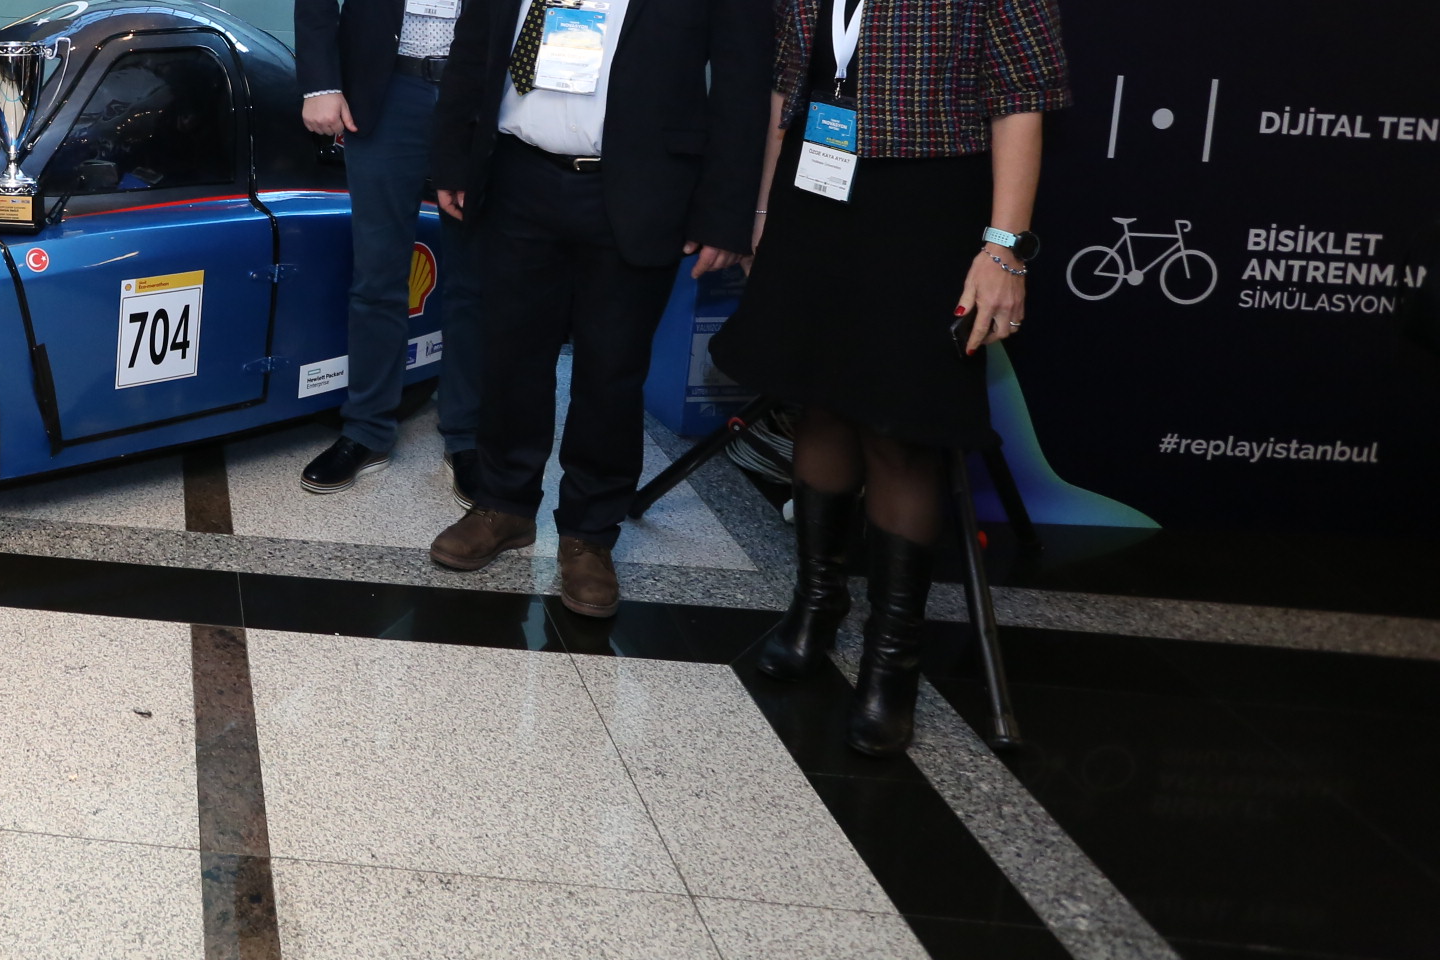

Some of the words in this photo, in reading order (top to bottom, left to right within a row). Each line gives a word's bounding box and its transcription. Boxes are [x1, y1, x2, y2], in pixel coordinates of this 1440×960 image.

[1259, 106, 1371, 138] DİJİTAL
[1246, 224, 1383, 256] BİSİKLET
[128, 304, 190, 368] 704
[307, 381, 329, 389] Enterprise
[326, 370, 344, 379] Packard
[1159, 433, 1378, 463] #replayistanbul
